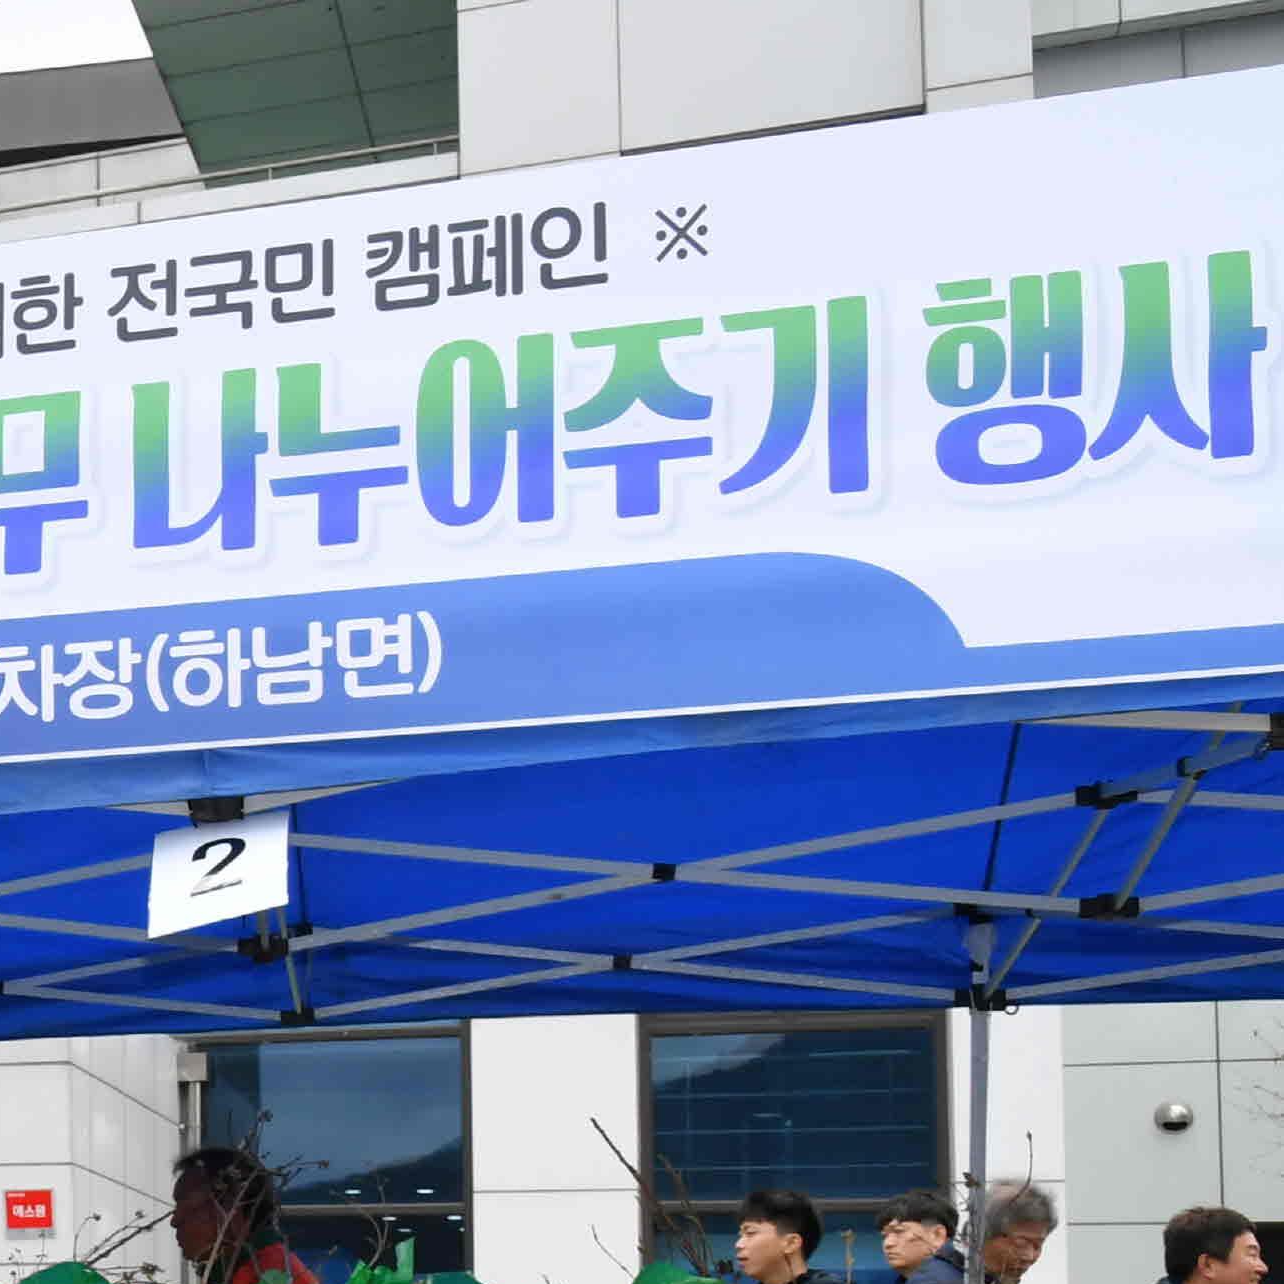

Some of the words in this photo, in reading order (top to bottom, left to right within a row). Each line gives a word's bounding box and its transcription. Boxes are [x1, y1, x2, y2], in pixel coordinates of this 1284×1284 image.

[107, 238, 336, 343] 전국민
[365, 201, 609, 312] 캠페인
[132, 295, 870, 552] 나누어주기
[923, 250, 1268, 487] 행사
[190, 837, 246, 898] 2
